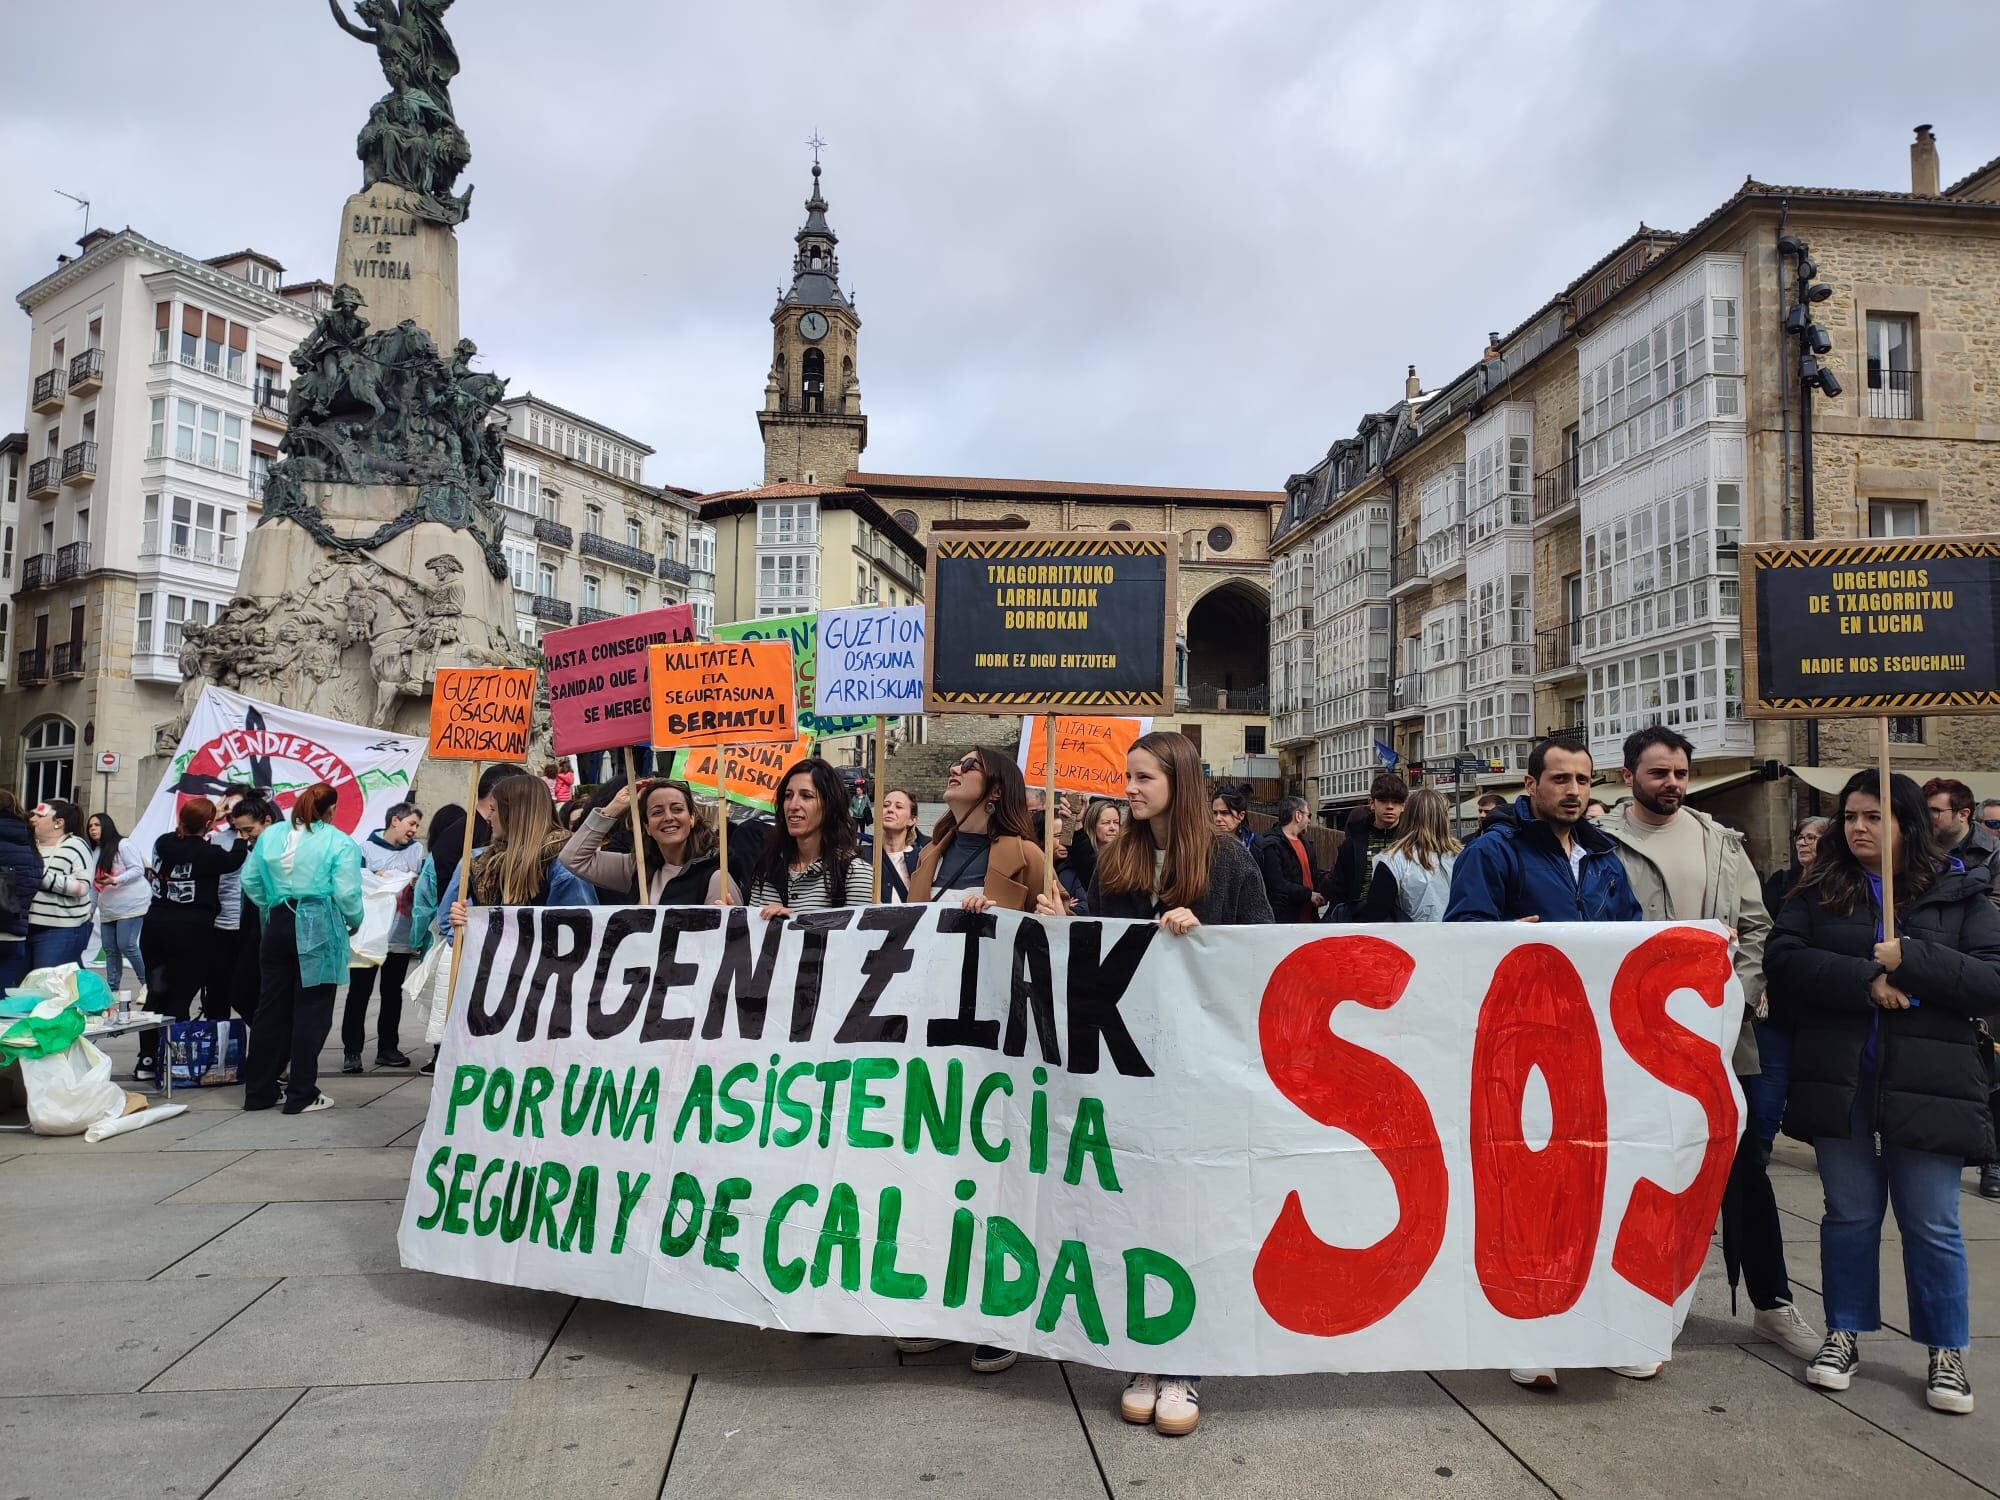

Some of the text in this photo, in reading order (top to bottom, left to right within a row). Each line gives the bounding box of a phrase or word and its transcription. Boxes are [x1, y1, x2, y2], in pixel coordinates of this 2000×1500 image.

[353, 214, 417, 236] BATALLA
[376, 241, 392, 254] DE
[354, 259, 411, 280] VITORIA
[987, 565, 1114, 584] TXAGORRITXUKO
[1832, 569, 1929, 591] URGENCIAS
[996, 588, 1098, 607] LARRIALDIAK
[1808, 590, 1954, 614] DE TXAGORRITXU
[1005, 610, 1089, 629] BORROKAN
[1840, 614, 1924, 635] EN LUCHA
[545, 649, 588, 673] HASTA
[672, 627, 695, 643] LA
[665, 648, 755, 671] KALITATEA
[844, 650, 915, 672] OSASUNA
[975, 653, 1117, 669] INORK EZ DIGU ENTZUTEN
[1801, 655, 1966, 674] NADIE NOS ESCUCHA!!!
[443, 673, 532, 702] GUZTION
[551, 675, 605, 701] SANIDAD
[609, 669, 637, 688] QUE
[702, 673, 728, 685] ETA
[665, 687, 775, 704] SEGURTASUNA
[449, 702, 525, 724] OSASUNA
[584, 696, 652, 724] SE MEREC
[668, 704, 788, 735] BERMATU!
[436, 722, 528, 754] ARRISKUAN
[1061, 738, 1086, 753] ETA
[208, 731, 353, 788] MENDIETAN
[467, 906, 1160, 1077] URGENTZIAK
[445, 1064, 555, 1139] POR
[560, 1063, 660, 1144] UNA
[1252, 926, 1740, 1338] SOS
[416, 1145, 600, 1254] SEGURA
[609, 1169, 651, 1255] Y
[659, 1171, 752, 1272] DE
